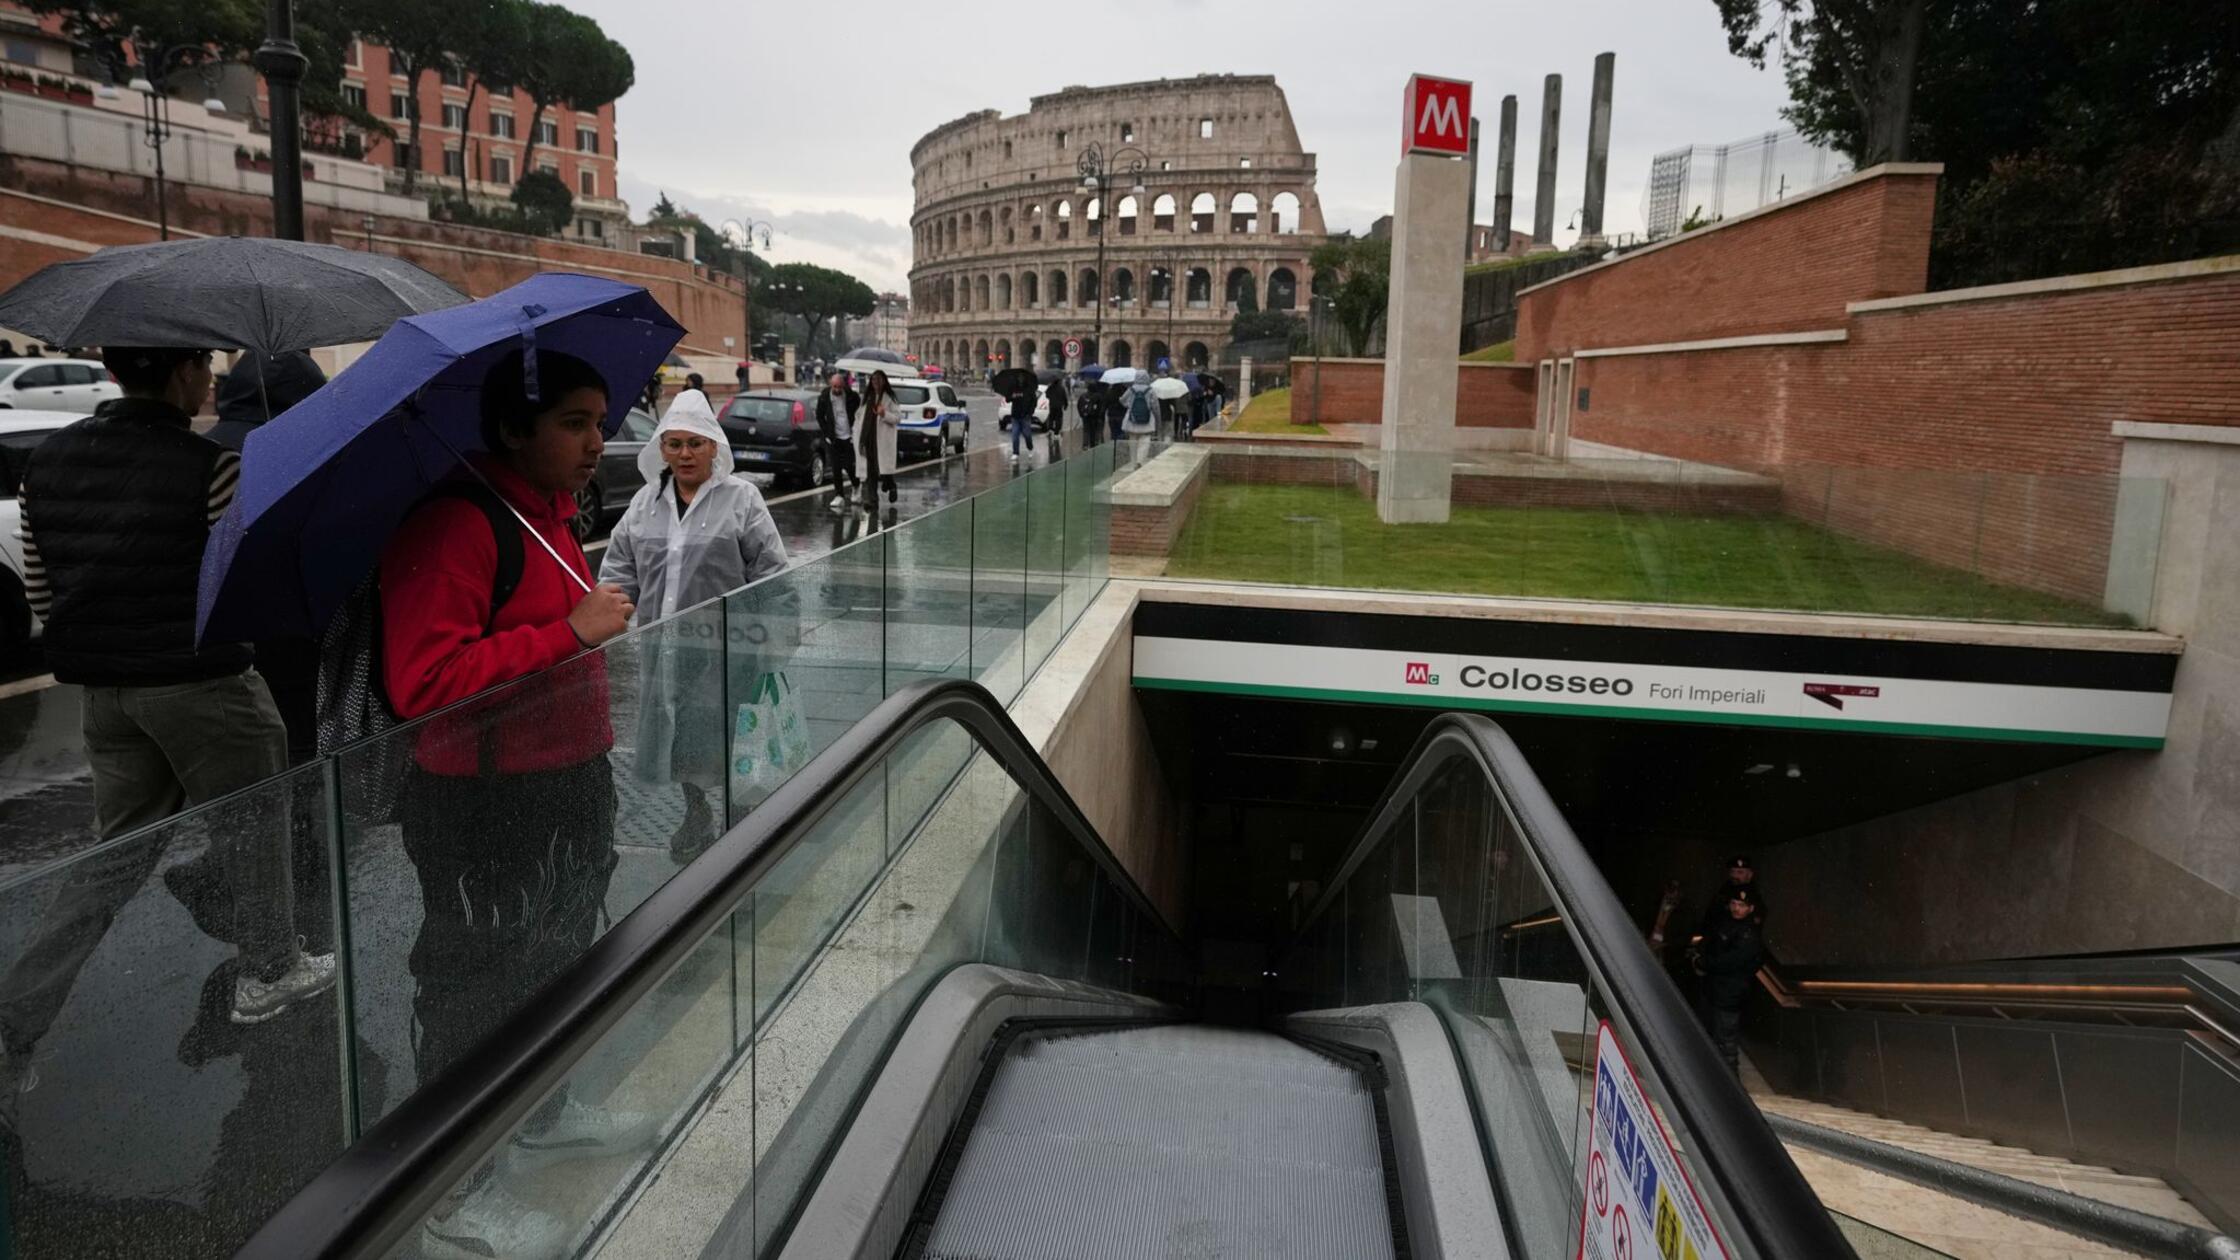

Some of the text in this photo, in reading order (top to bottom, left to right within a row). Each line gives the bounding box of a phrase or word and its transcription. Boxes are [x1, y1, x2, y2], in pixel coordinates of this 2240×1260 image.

[1418, 93, 1464, 139] M
[1459, 665, 1634, 696] Colosseo
[1649, 683, 1683, 700] Fori
[1688, 685, 1765, 705] Imperiali
